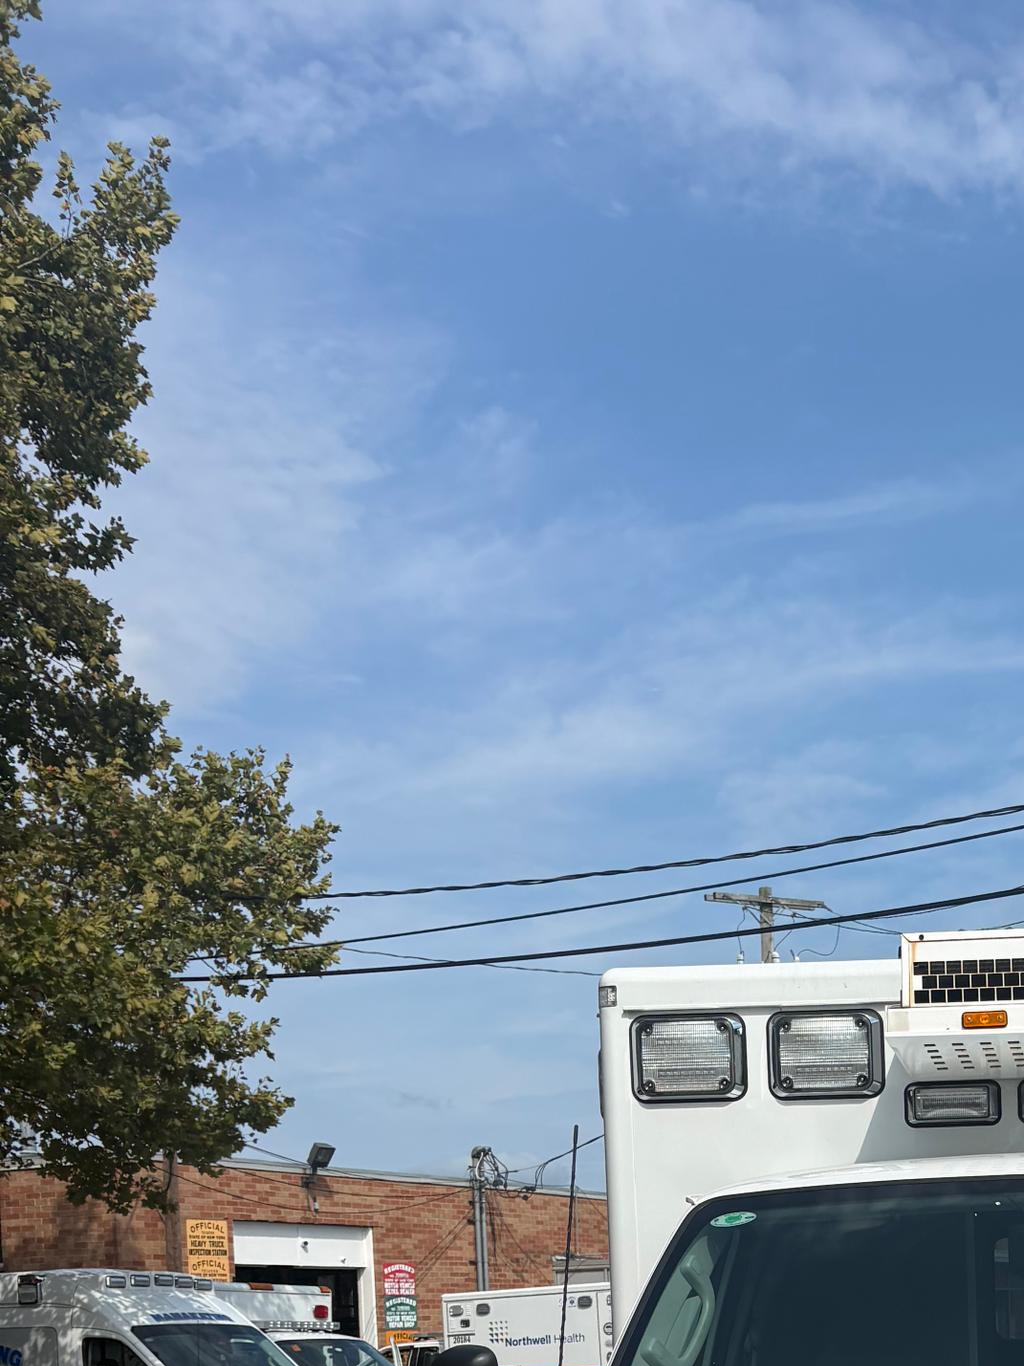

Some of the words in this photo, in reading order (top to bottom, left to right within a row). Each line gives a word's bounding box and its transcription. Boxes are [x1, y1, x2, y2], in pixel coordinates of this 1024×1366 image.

[190, 1222, 225, 1234] OFFICIAL
[190, 1240, 207, 1248] HEAVY
[208, 1240, 225, 1248] TRUCK
[188, 1248, 211, 1256] INSPECTION
[192, 1260, 227, 1272] OFFICIAL
[386, 1296, 417, 1308] REGISTERED
[453, 1336, 471, 1344] 20184
[505, 1334, 551, 1347] Northwell
[554, 1332, 585, 1345] Health
